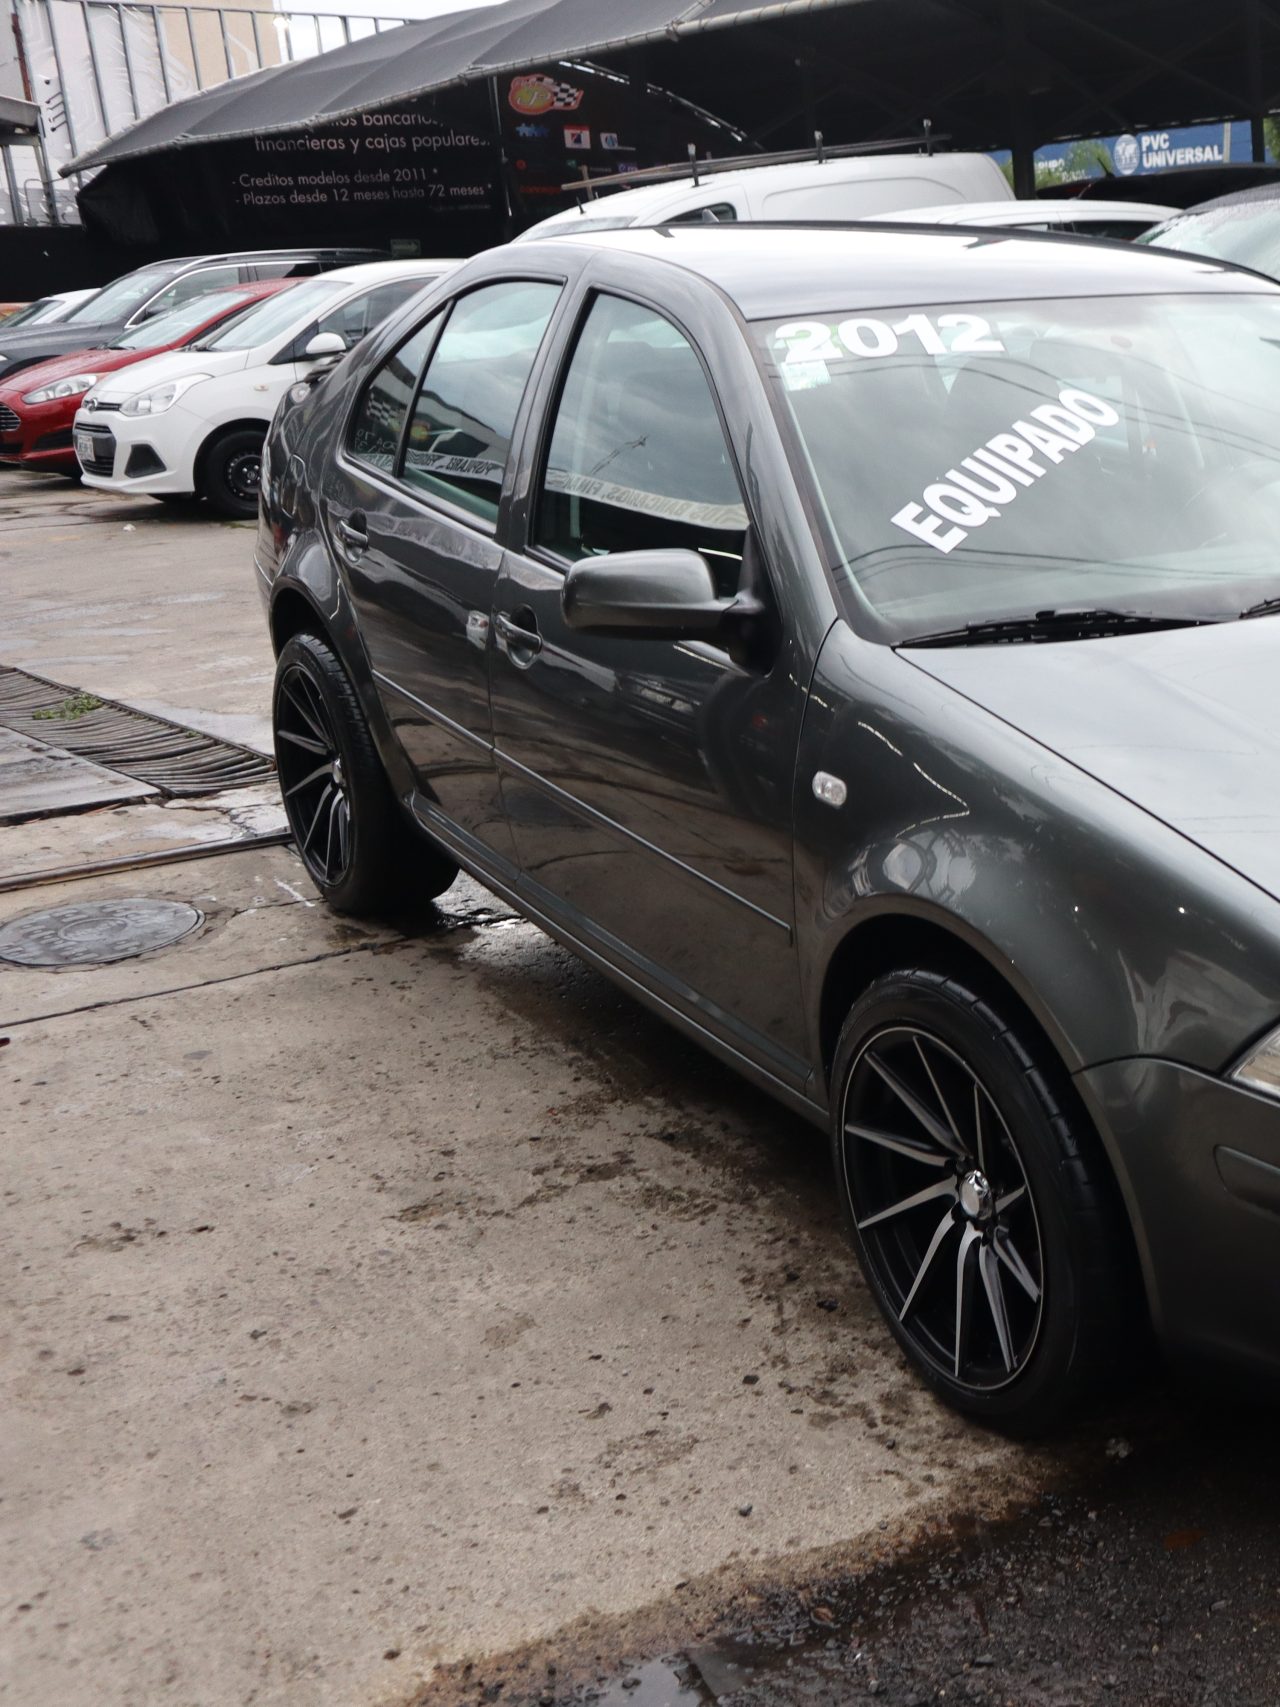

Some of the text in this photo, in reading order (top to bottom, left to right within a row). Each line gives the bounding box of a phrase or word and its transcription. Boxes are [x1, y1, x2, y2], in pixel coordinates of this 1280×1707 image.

[254, 135, 347, 152] financieras
[350, 138, 360, 154] y
[365, 132, 407, 153] cajas
[1141, 133, 1170, 152] PVC
[1142, 145, 1223, 169] UNIVERSAL
[239, 167, 426, 187] Creditos modelos desde 2011
[243, 183, 485, 205] Plazos desde 12 meses hasta 72 meses
[775, 313, 1006, 364] 2012
[890, 389, 1120, 555] EQUIPADO
